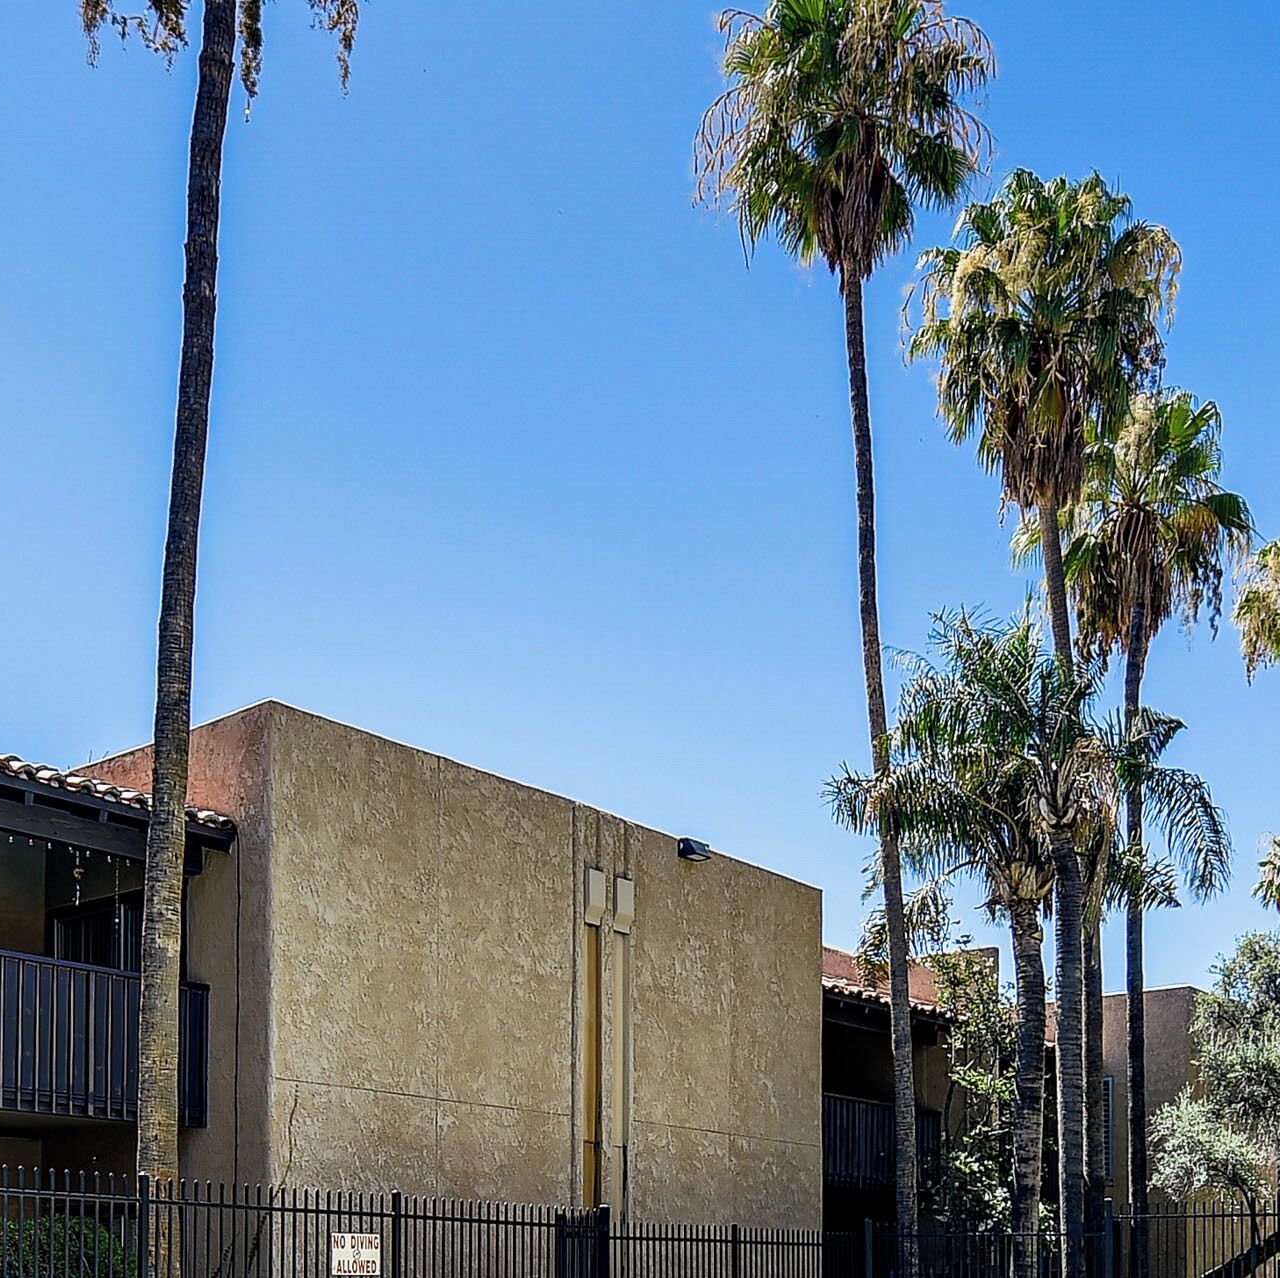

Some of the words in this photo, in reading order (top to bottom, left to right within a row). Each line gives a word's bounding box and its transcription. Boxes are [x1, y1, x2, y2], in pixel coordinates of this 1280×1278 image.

[333, 1235, 346, 1249] NO
[350, 1235, 380, 1250] DIVING
[336, 1260, 377, 1274] ALLOWED
